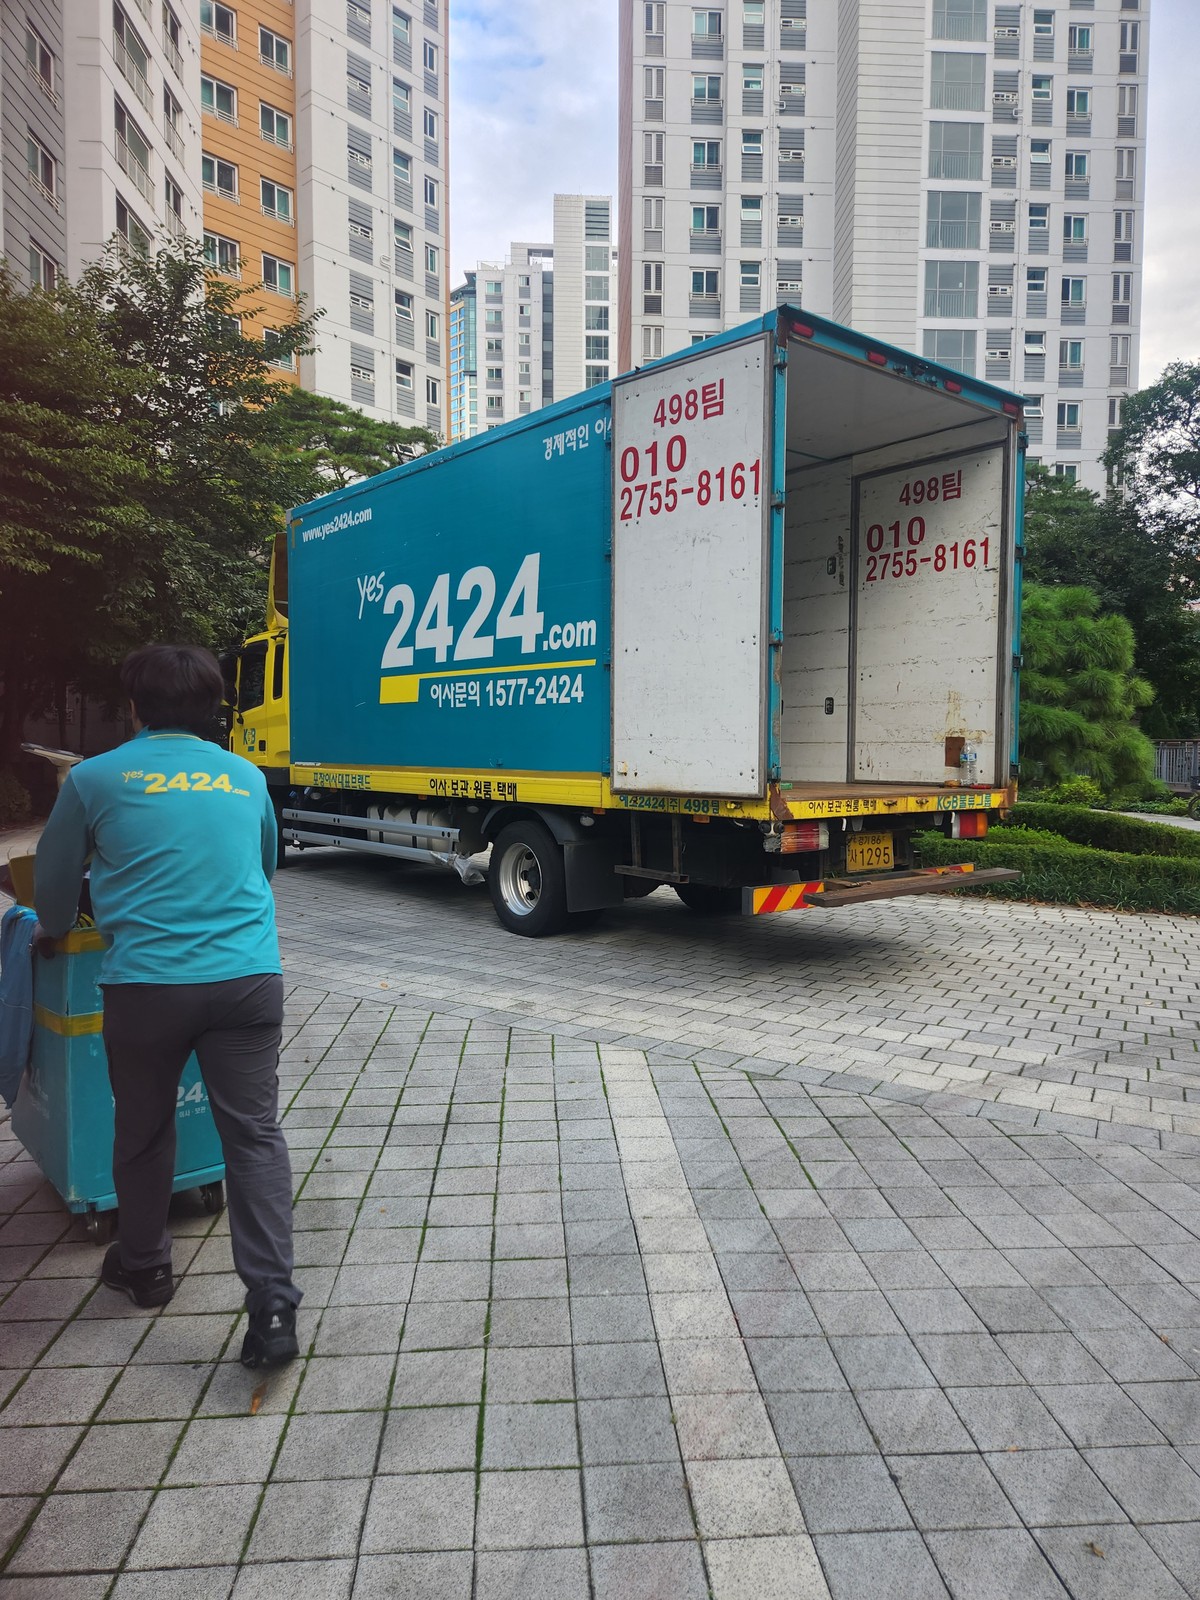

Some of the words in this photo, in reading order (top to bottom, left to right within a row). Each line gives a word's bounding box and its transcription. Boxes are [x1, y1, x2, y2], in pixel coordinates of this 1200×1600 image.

[653, 378, 724, 428] 498팀
[543, 424, 589, 460] 경제적인
[620, 434, 687, 483] 010
[620, 458, 760, 521] 2755-8161
[899, 469, 962, 506] 498팀
[302, 507, 372, 542] www.yes2424.com
[866, 516, 926, 552] 010
[866, 536, 989, 582] 2755-8161
[430, 681, 480, 708] 이사문의
[485, 673, 584, 707] 1577-2424
